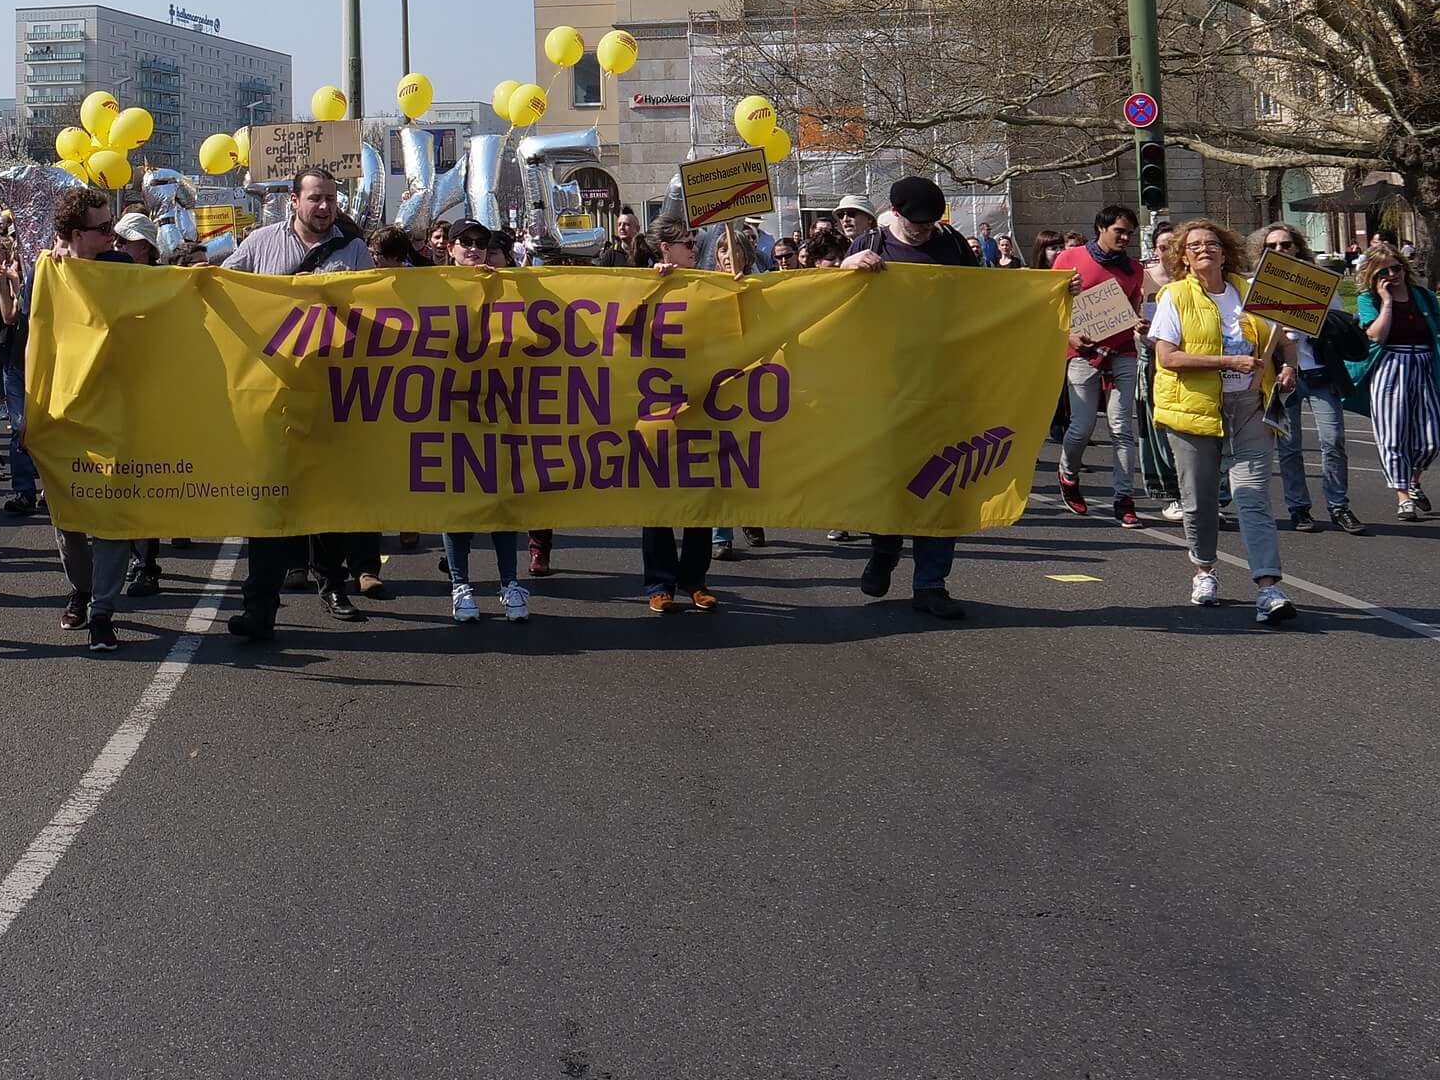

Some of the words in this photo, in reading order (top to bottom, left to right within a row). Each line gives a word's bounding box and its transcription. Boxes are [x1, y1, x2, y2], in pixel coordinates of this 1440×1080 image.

[273, 126, 323, 145] Stoppt
[265, 141, 310, 156] endlich
[275, 154, 297, 164] den
[687, 166, 740, 186] Eschershauser
[742, 161, 762, 174] Weg
[1264, 262, 1331, 298] Baumschulenweg
[1072, 282, 1120, 315] EUTSCHE
[366, 299, 688, 363] DEUTSCHE
[327, 364, 613, 425] WOHNEN
[636, 367, 689, 421] &
[702, 362, 791, 423] CO
[71, 457, 194, 479] dwenteignen.de
[408, 429, 762, 495] ENTEIGNEN
[70, 482, 290, 501] facebook.com/DWenteignen
